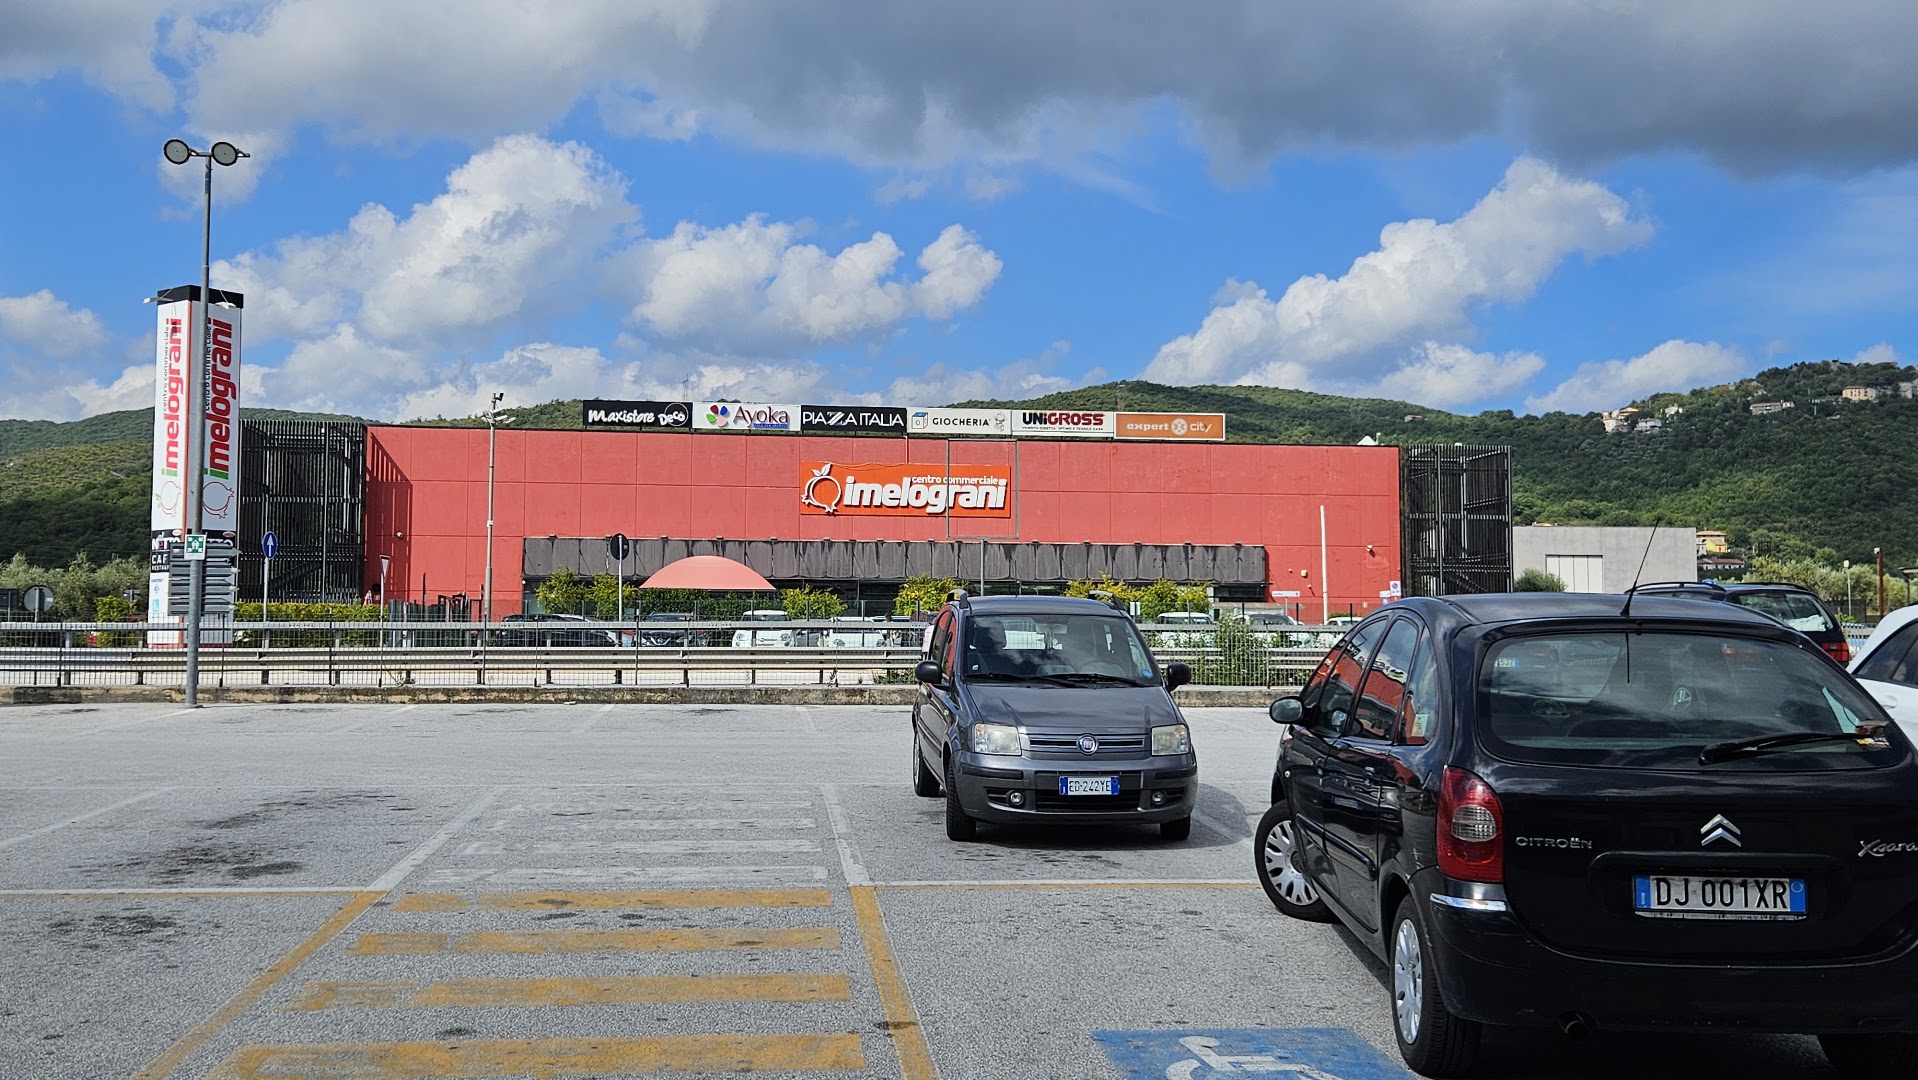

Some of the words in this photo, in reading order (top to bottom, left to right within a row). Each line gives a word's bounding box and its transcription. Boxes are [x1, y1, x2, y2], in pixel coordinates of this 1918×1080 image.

[588, 410, 656, 423] Maxistore
[733, 406, 789, 428] Ayoka
[803, 411, 857, 426] PIAZZA
[860, 412, 904, 427] ITALIA
[932, 417, 989, 427] GIOCHERIA
[1126, 422, 1169, 432] expert
[1189, 421, 1213, 433] city
[912, 475, 941, 484] centro
[943, 476, 998, 485] commerciale
[1515, 836, 1592, 849] CITROËN
[1656, 877, 1690, 906] DJ
[1701, 879, 1788, 909] 001XR
